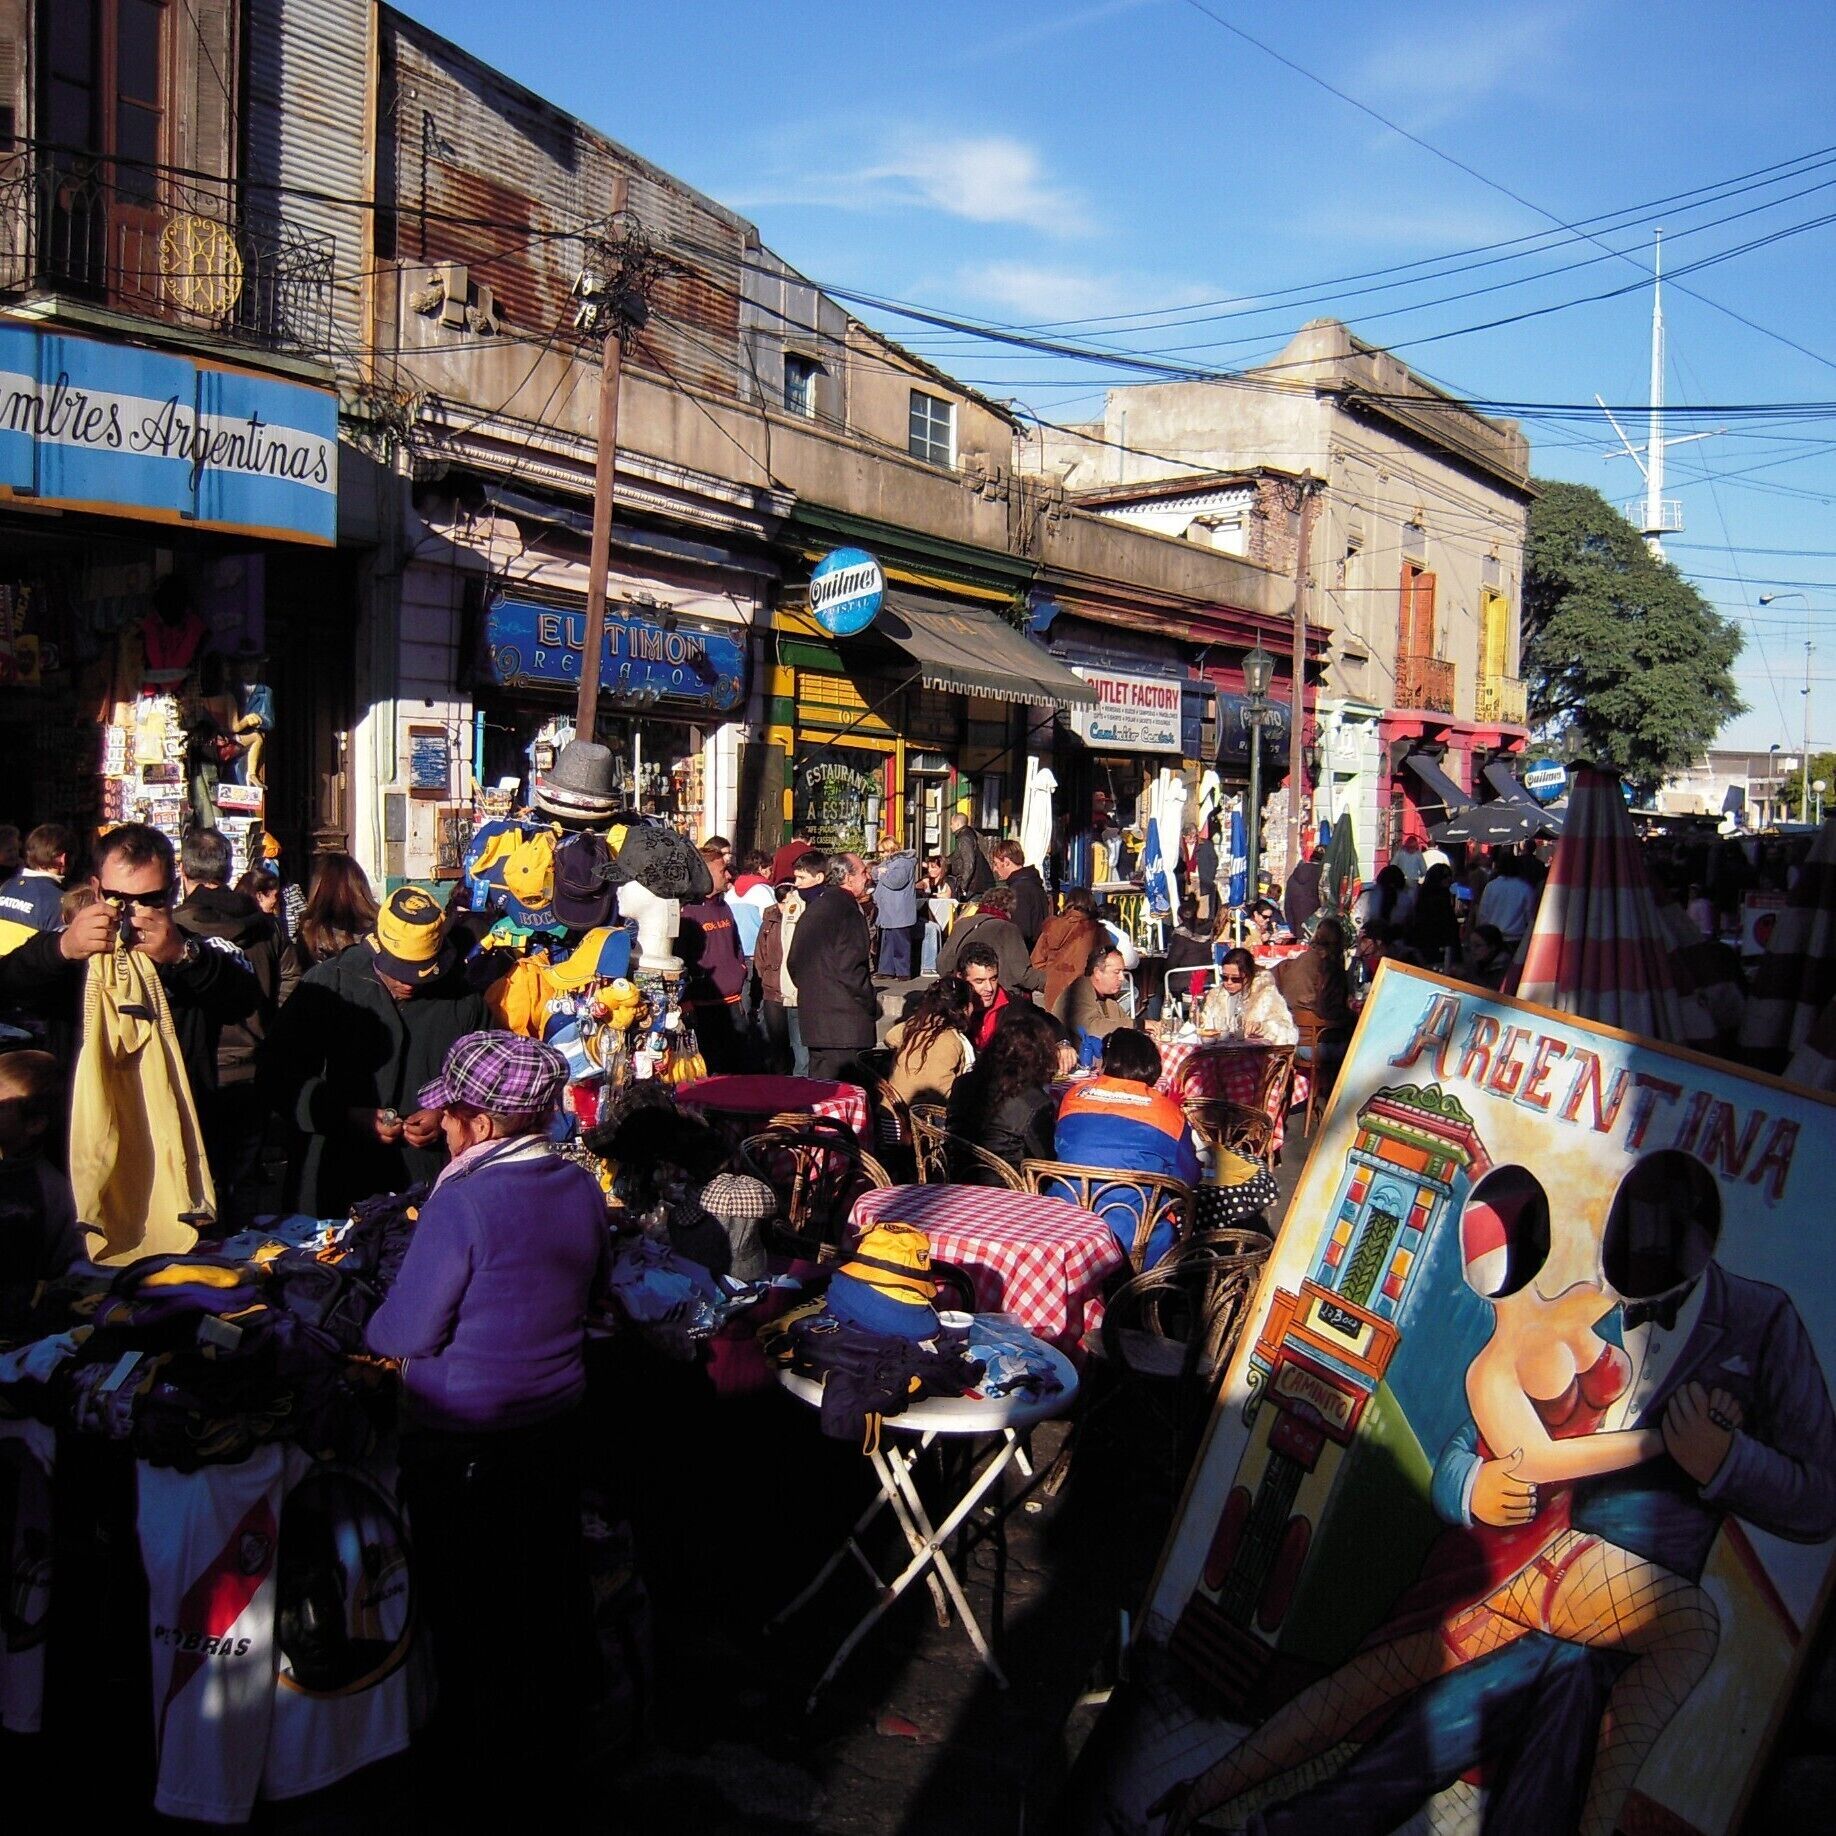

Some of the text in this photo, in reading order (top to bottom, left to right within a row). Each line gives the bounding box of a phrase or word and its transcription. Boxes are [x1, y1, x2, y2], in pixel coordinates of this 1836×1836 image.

[0, 372, 328, 492] mbres Argentinas
[811, 568, 876, 610] Quilmes
[1131, 683, 1179, 710] FACTORY
[805, 763, 868, 796] ESTAURANT
[519, 910, 557, 926] BOC
[1388, 990, 1802, 1202] ARGENTINA
[1281, 1366, 1348, 1420] CAMINITO
